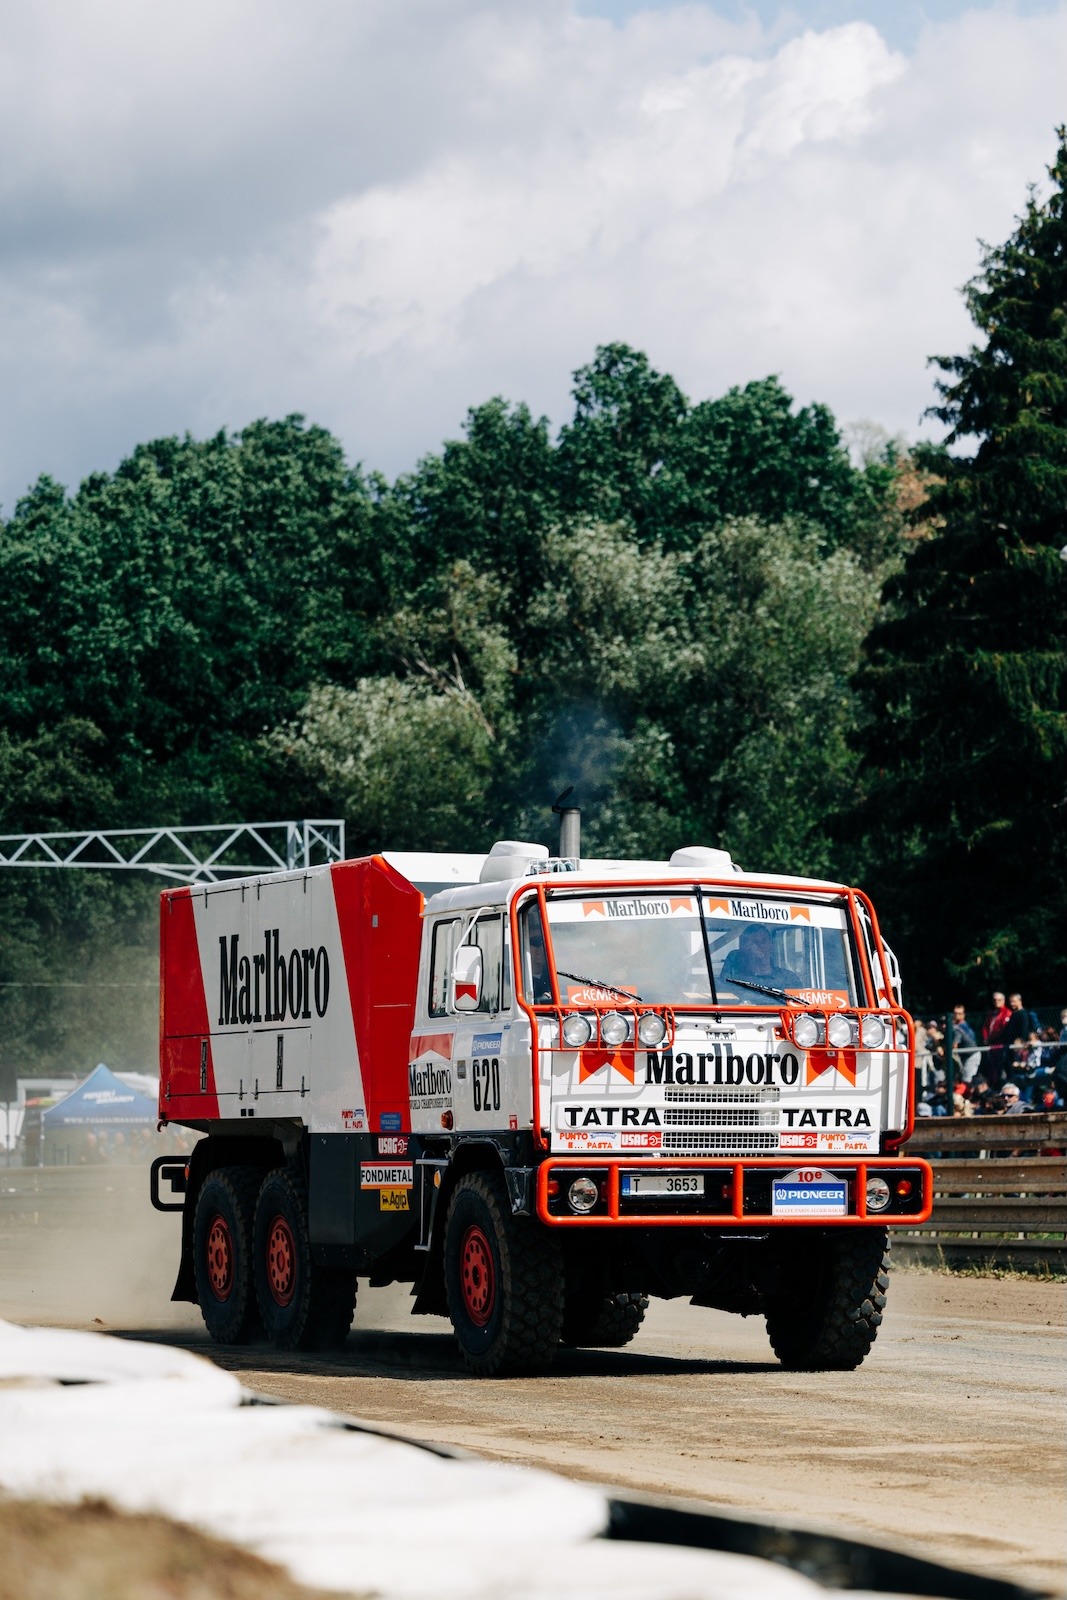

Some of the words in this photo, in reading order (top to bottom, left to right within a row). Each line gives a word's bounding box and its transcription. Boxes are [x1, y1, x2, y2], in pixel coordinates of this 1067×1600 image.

[607, 899, 669, 917] Marlboro
[731, 900, 789, 922] Marlboro
[218, 928, 330, 1026] Marlboro
[799, 991, 834, 1005] KEMPF
[477, 1040, 501, 1050] PIONEER
[645, 1043, 799, 1086] Marlboro
[409, 1062, 452, 1097] Marlboro
[472, 1058, 501, 1112] 620
[341, 1110, 354, 1119] PUNTO
[564, 1106, 661, 1127] TATRA
[782, 1107, 871, 1128] TATRA
[559, 1132, 589, 1141] PUNTO
[622, 1133, 648, 1146] USAG
[780, 1134, 806, 1146] USAG
[820, 1133, 847, 1142] PUNTO
[377, 1137, 398, 1154] USAG
[587, 1141, 613, 1149] PASTA
[844, 1142, 868, 1150] PASTA
[361, 1169, 413, 1183] FONDMETAL
[798, 1171, 823, 1183] 10e
[633, 1178, 641, 1193] T
[666, 1178, 698, 1192] 3653
[389, 1191, 407, 1209] Agip
[788, 1190, 844, 1199] PIONEER
